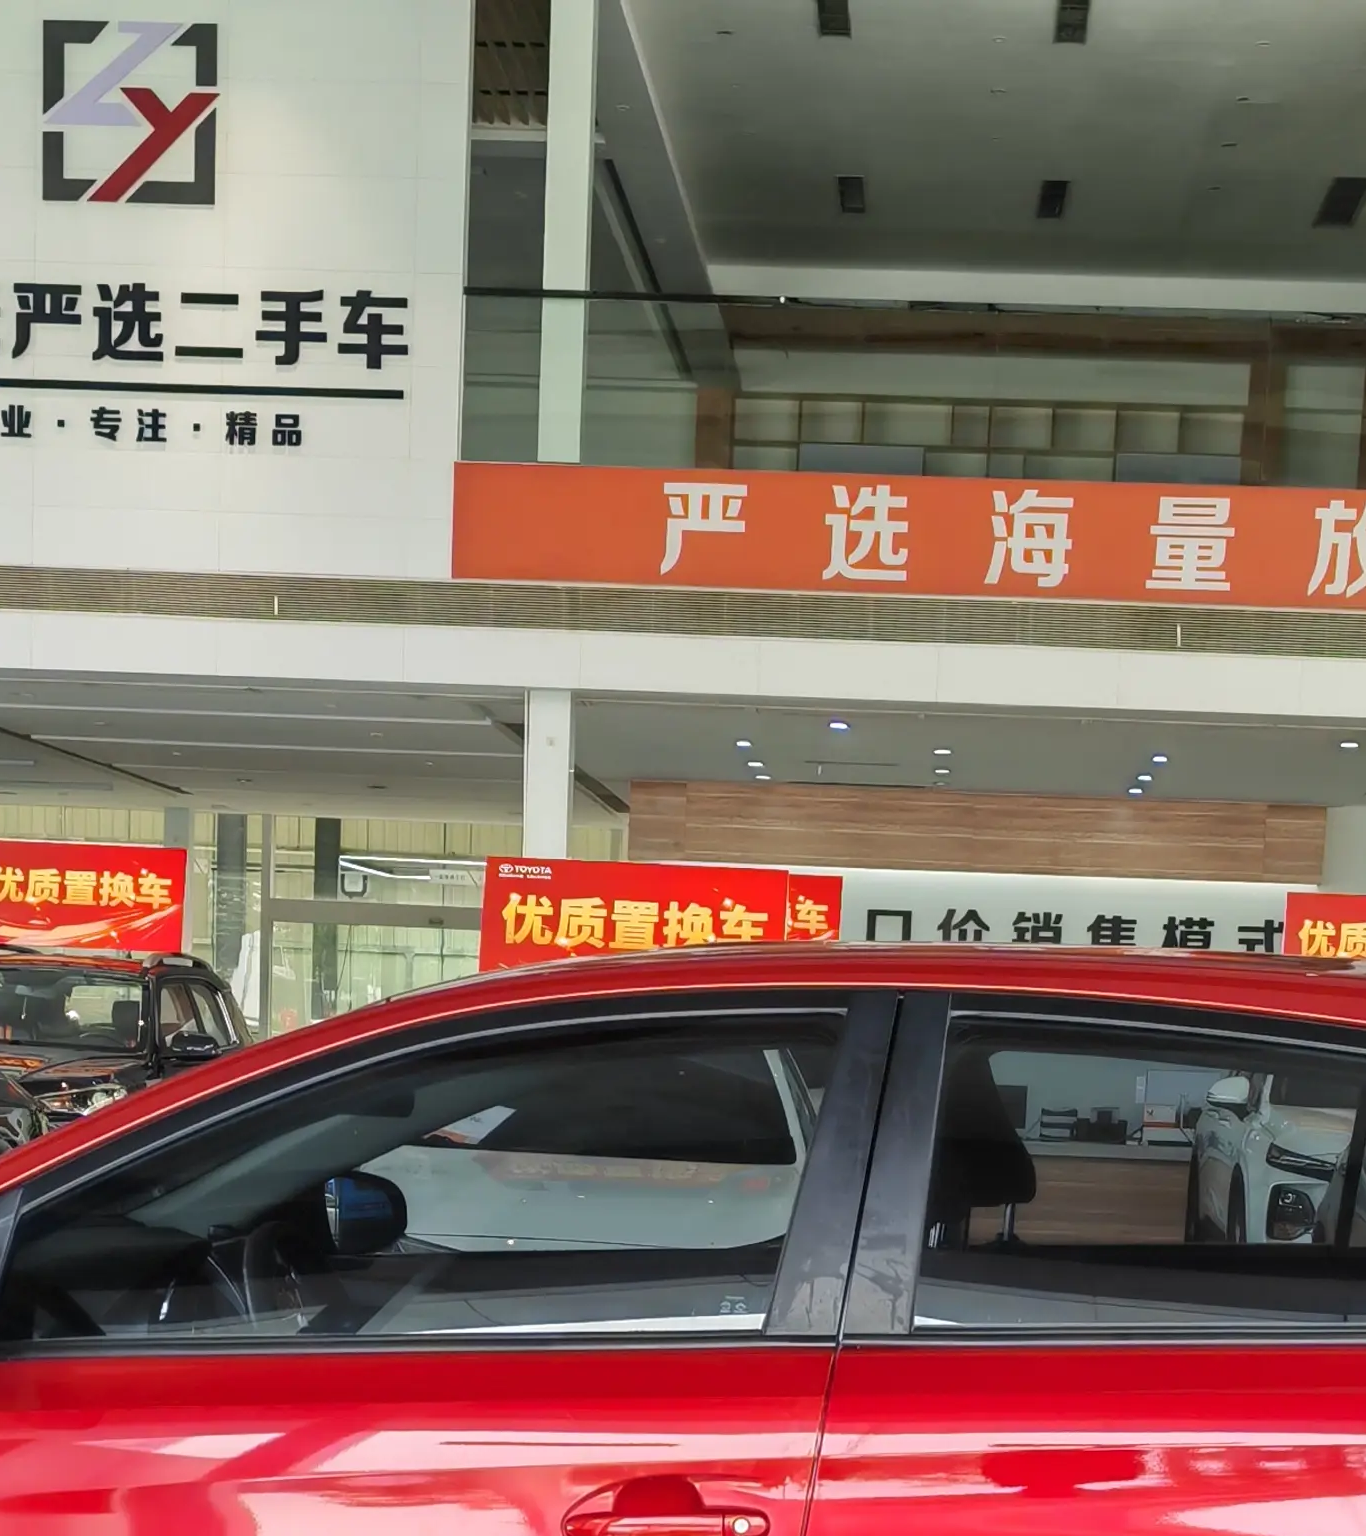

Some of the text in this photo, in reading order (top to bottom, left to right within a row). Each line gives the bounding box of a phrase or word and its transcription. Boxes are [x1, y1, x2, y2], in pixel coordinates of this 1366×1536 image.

[514, 865, 552, 875] TOYOTA
[501, 892, 769, 950] 优质置换车
[788, 899, 829, 934] 车
